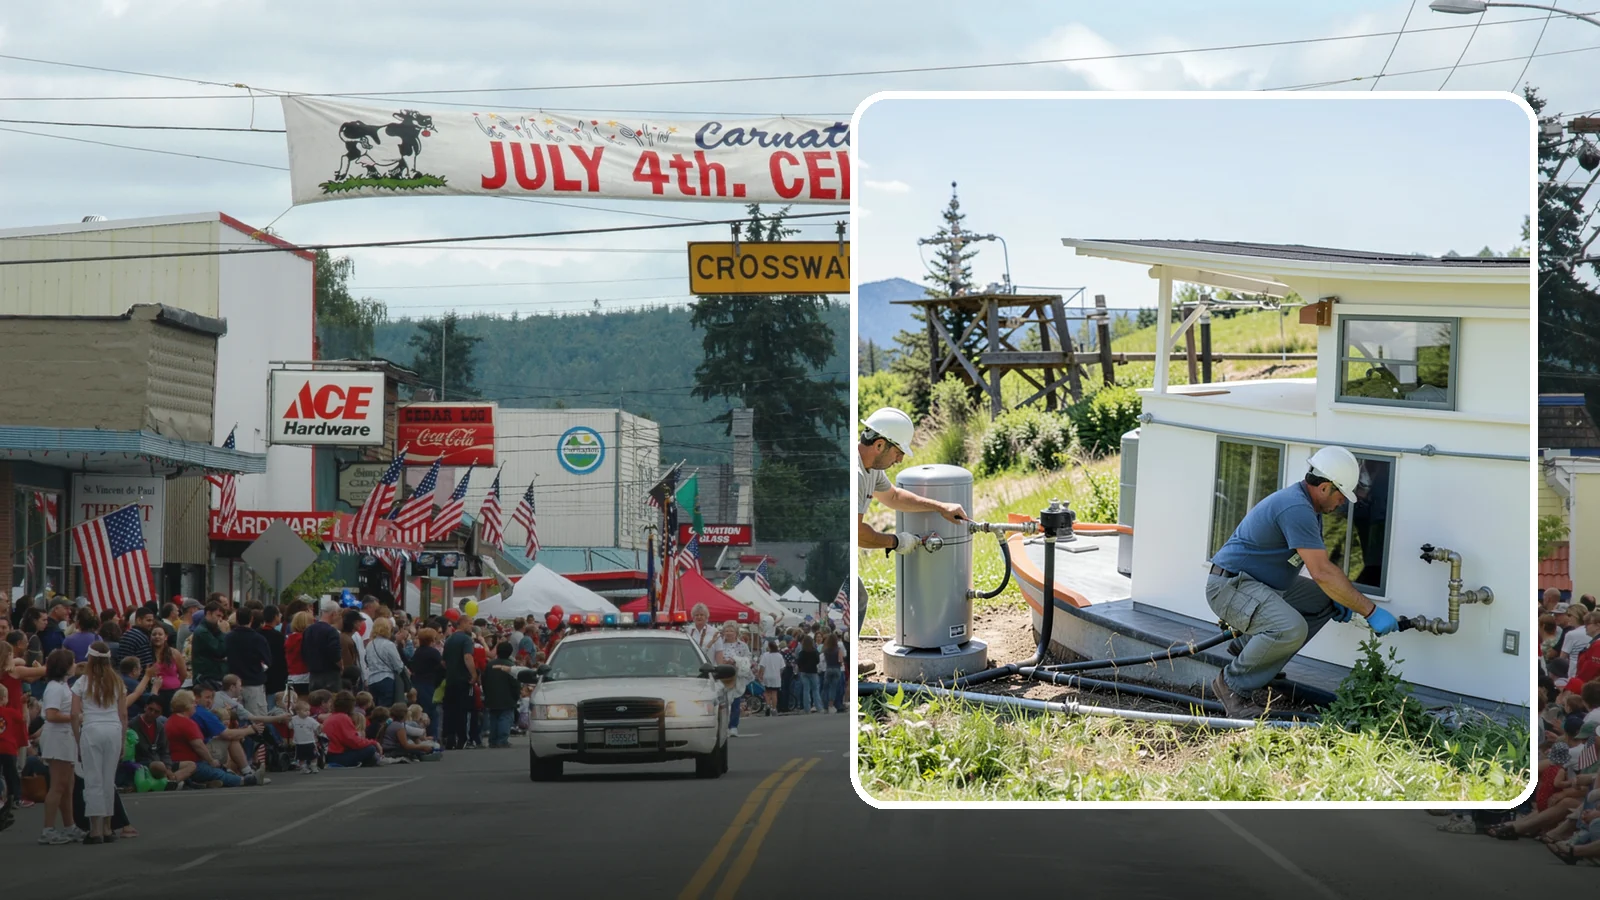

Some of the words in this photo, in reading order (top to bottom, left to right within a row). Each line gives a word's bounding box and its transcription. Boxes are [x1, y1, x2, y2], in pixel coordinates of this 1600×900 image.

[695, 121, 850, 149] Carnat
[481, 141, 605, 193] JULY
[632, 150, 746, 198] 4th.
[697, 254, 850, 280] CROSSWA
[282, 380, 373, 420] ACE
[405, 409, 452, 422] CEDAR
[283, 421, 370, 436] Hardware
[416, 428, 477, 447] Coca-Cola
[83, 485, 94, 494] St.
[96, 485, 124, 495] Vincent
[126, 486, 136, 495] de
[137, 486, 155, 495] Paul
[688, 526, 741, 535] CRNATION
[699, 535, 730, 543] GLASS
